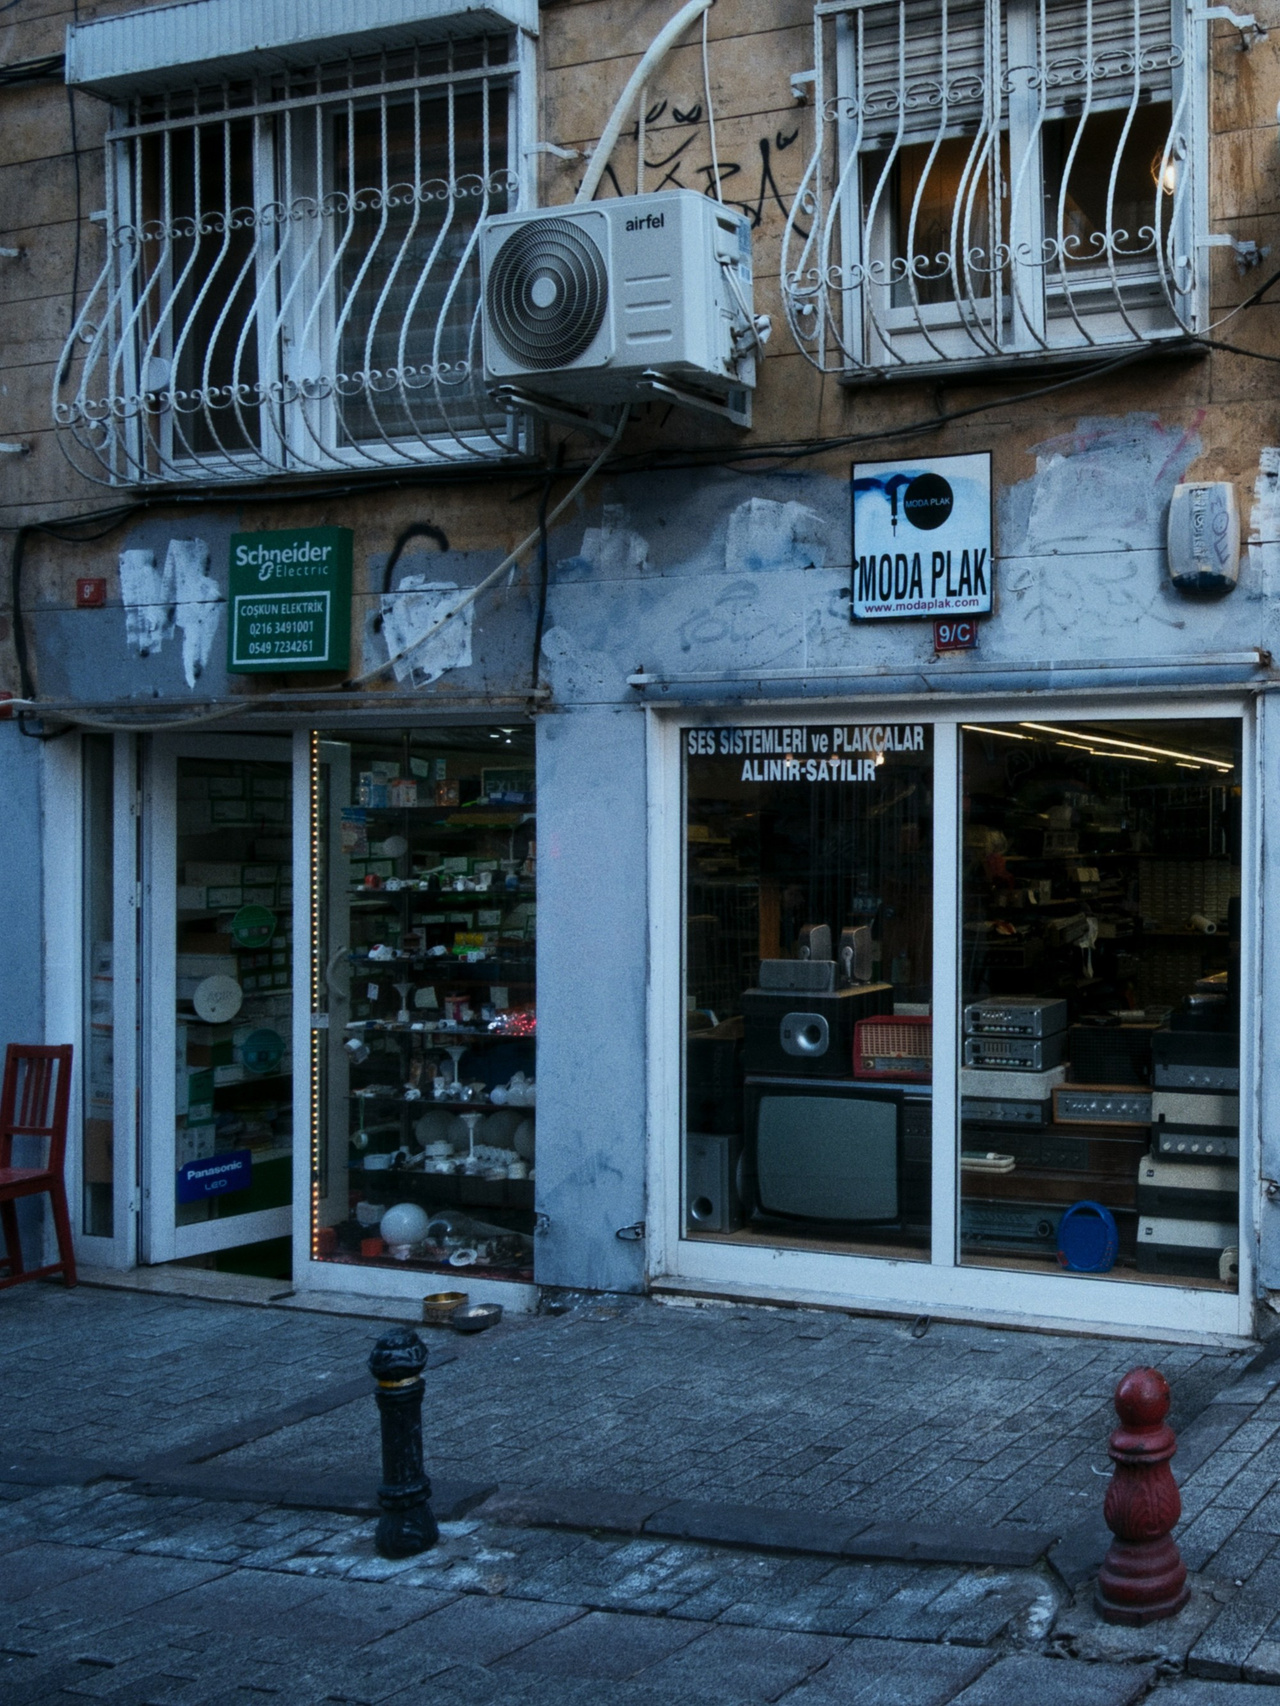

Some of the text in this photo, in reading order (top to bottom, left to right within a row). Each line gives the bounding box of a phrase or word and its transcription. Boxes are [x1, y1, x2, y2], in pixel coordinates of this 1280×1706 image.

[626, 213, 664, 231] airfel
[905, 497, 951, 508] MODA PLAK
[236, 541, 332, 566] Schneider
[275, 564, 329, 578] Electric
[858, 552, 924, 602] MODA
[931, 548, 987, 598] PLAK
[241, 600, 324, 618] COŞKUN ELEKTRİK
[865, 598, 979, 613] www.modaplak.com
[249, 621, 314, 635] 0216 3491001
[938, 624, 971, 643] 9/C
[249, 640, 313, 654] 0549 7234261
[688, 725, 924, 755] SES SİSTEMLERİ ve PLAKÇALAR
[741, 759, 876, 782] ALINIR-SATILIR
[187, 1160, 243, 1180] Panasonic
[204, 1179, 228, 1191] LED
